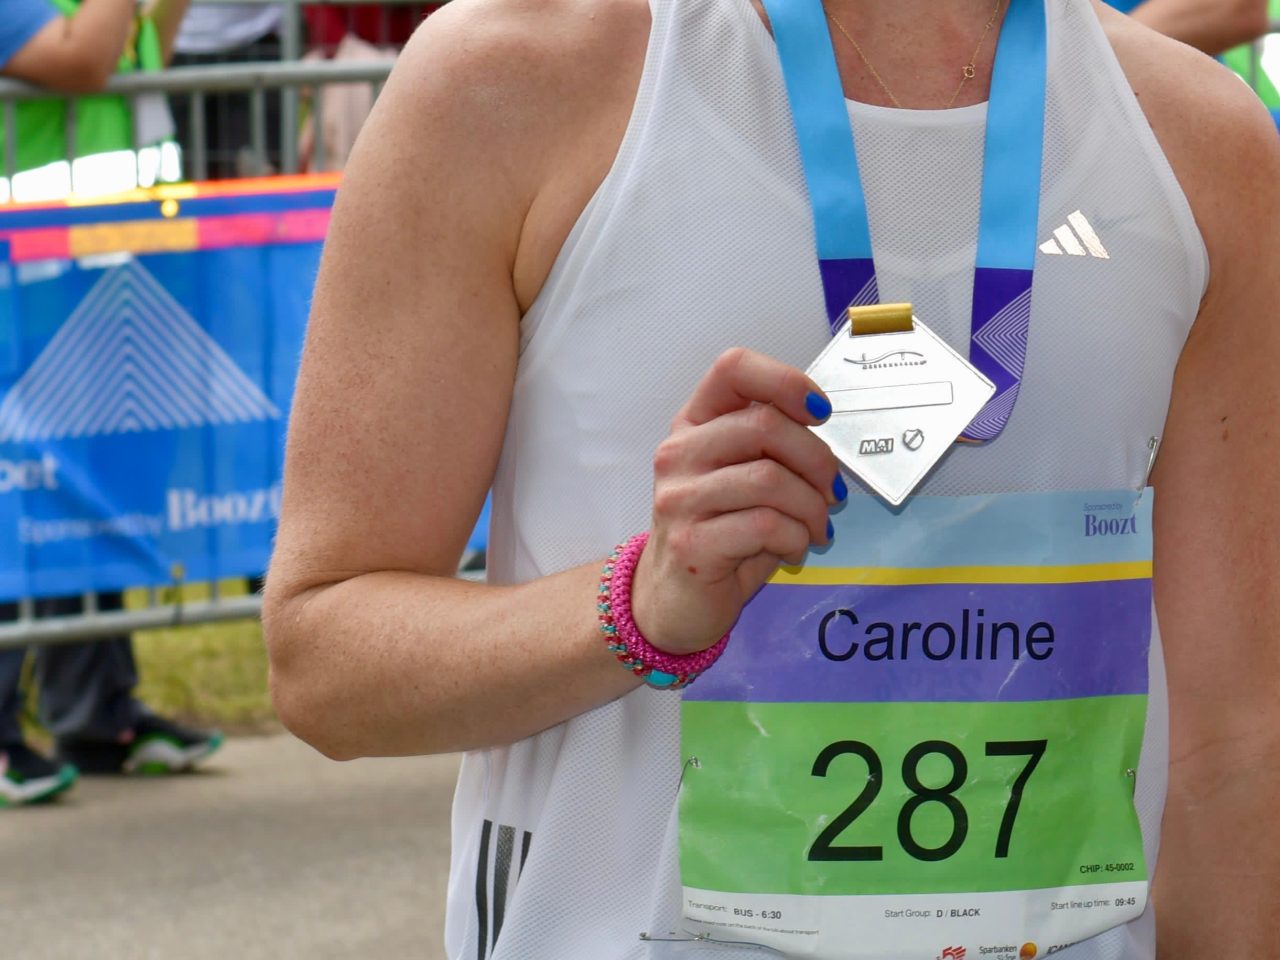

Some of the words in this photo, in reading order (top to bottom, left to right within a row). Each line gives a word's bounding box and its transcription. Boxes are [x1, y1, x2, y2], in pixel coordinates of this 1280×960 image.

[1084, 513, 1137, 537] Boozt
[817, 608, 1056, 662] Caroline
[807, 739, 1049, 862] 287
[1079, 865, 1103, 874] CHIP:
[1104, 863, 1135, 872] 45-0002
[1050, 902, 1069, 910] Start
[1070, 900, 1082, 908] line
[1114, 897, 1136, 907] 09:45
[733, 908, 754, 918] BUS
[761, 910, 782, 920] 6:30
[885, 909, 904, 918] Start
[936, 909, 943, 918] D
[950, 908, 981, 917] BLACK
[979, 945, 1018, 956] Sparbanken
